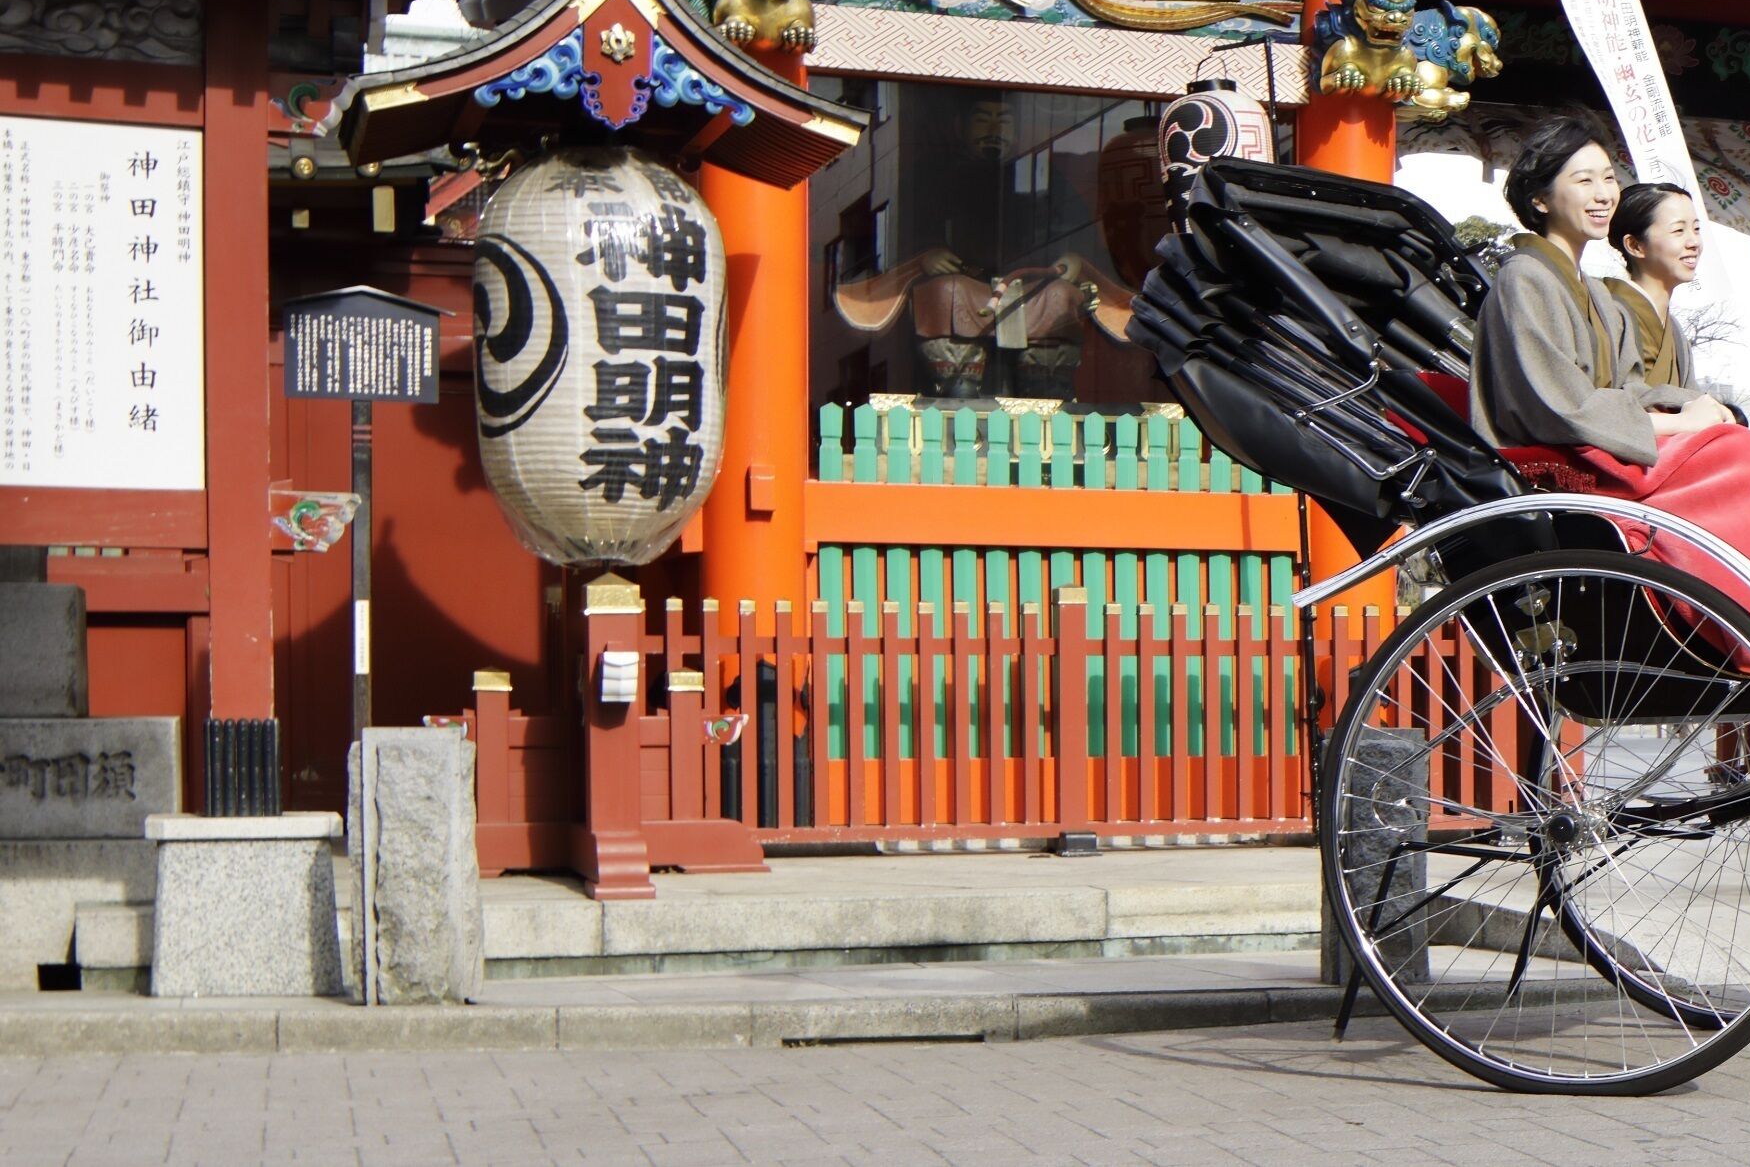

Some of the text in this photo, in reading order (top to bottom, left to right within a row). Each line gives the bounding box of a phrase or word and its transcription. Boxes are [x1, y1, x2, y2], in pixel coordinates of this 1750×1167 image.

[127, 150, 160, 432] 神田神社御由緒
[177, 210, 192, 264] 神田明神
[576, 199, 707, 512] 神田明神
